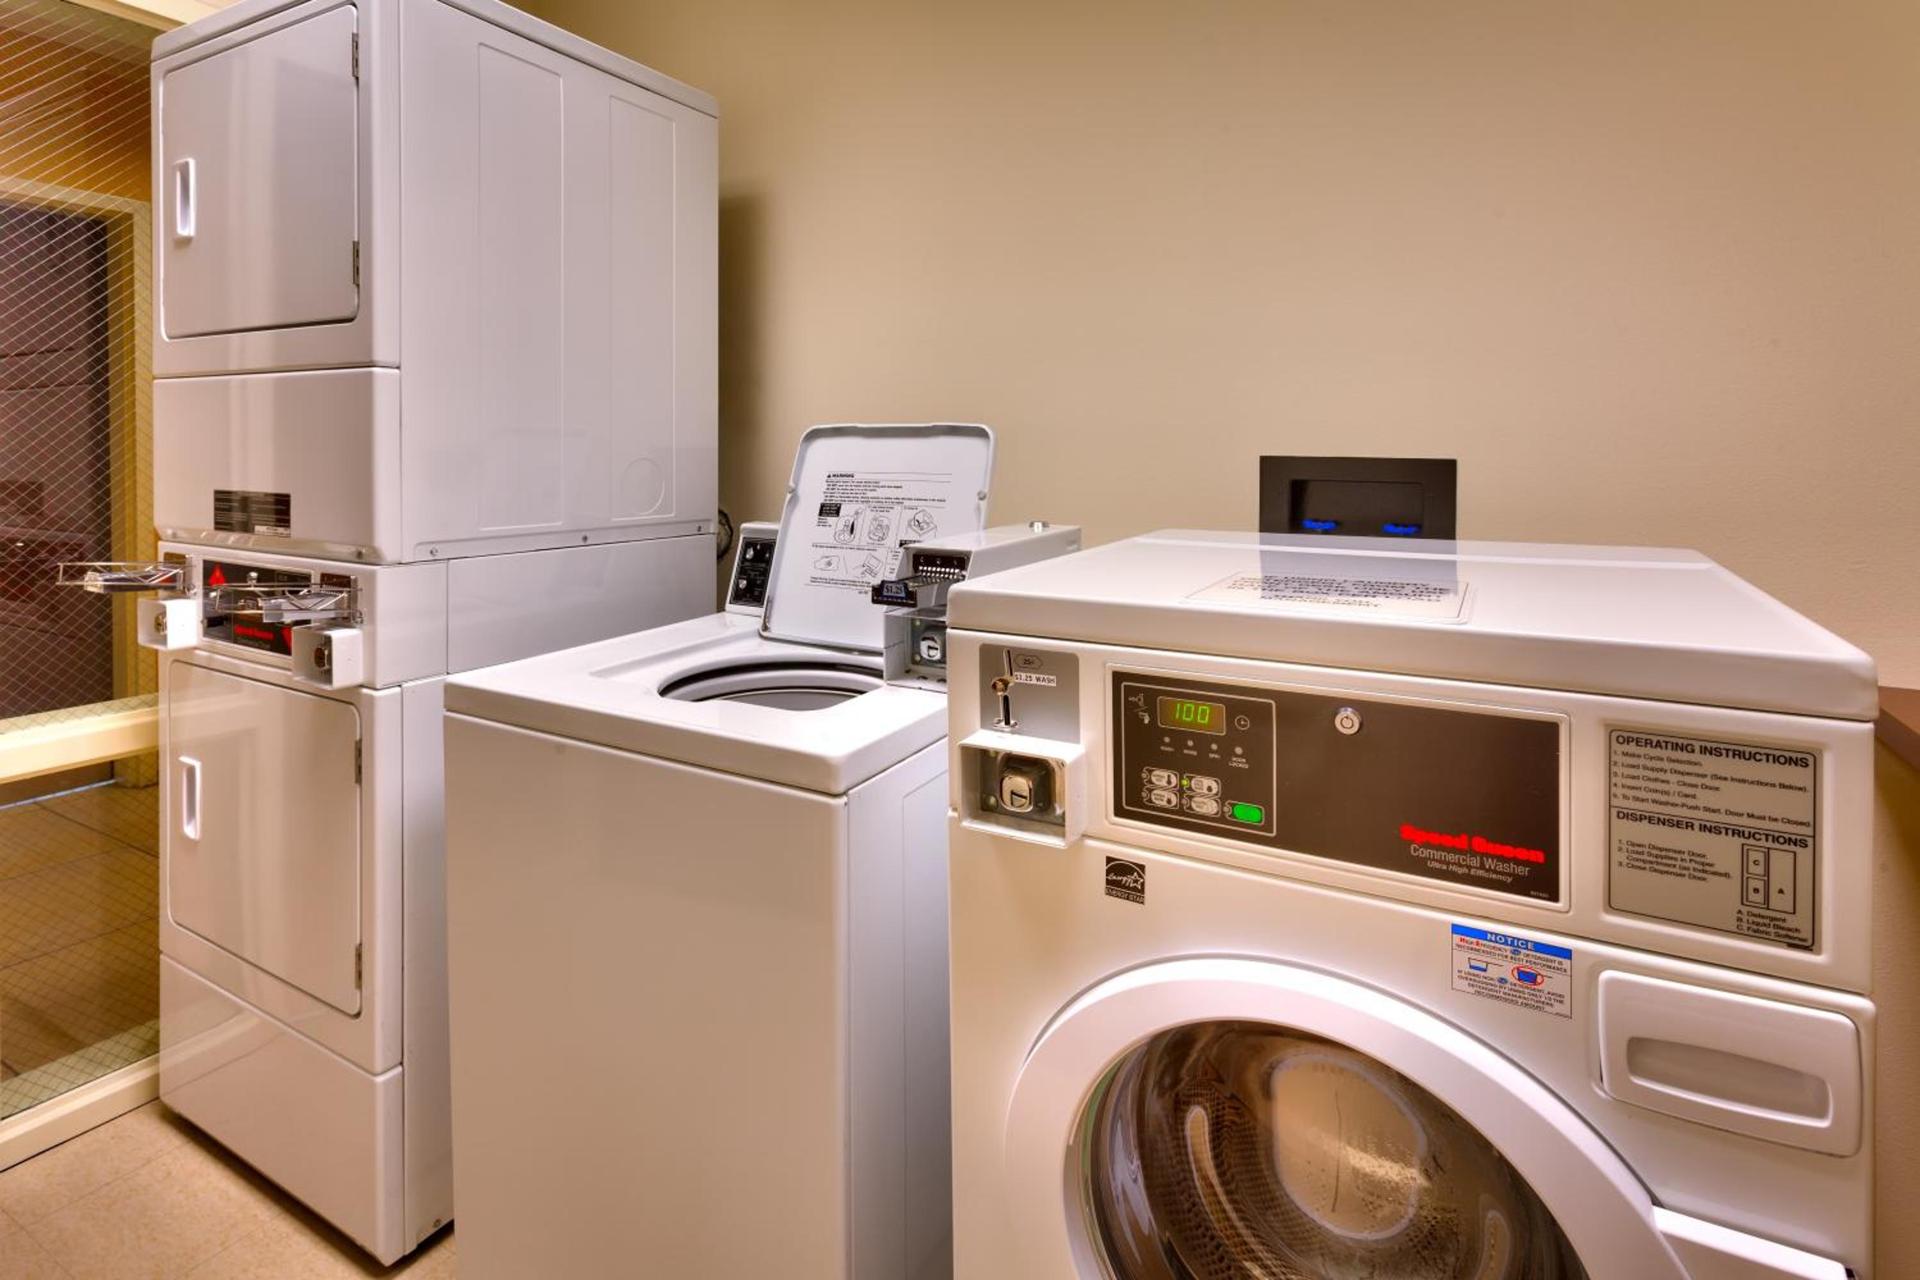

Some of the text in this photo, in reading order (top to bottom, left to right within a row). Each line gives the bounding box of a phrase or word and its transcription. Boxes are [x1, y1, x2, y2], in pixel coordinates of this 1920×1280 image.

[1175, 703, 1210, 724] 100
[1615, 734, 1810, 768] OPERATING INSTRUCTIONS
[1641, 764, 1668, 774] Supply
[1669, 768, 1708, 778] Dispenser
[1616, 810, 1809, 848] DISPENSER INSTRUCTIONS
[1626, 840, 1647, 849] Open
[1647, 843, 1685, 855] Dispenser
[1626, 848, 1645, 856] Load
[1646, 850, 1679, 862] Supplies
[1410, 843, 1531, 876] Commercial Washer
[1427, 860, 1513, 883] Ultra High Efficiency
[1777, 887, 1785, 895] A
[1747, 910, 1786, 923] Detergent
[1747, 918, 1771, 929] Liquid
[1772, 923, 1801, 933] Bleach
[1747, 926, 1772, 936] Fabric
[1486, 932, 1535, 951] NOTICE
